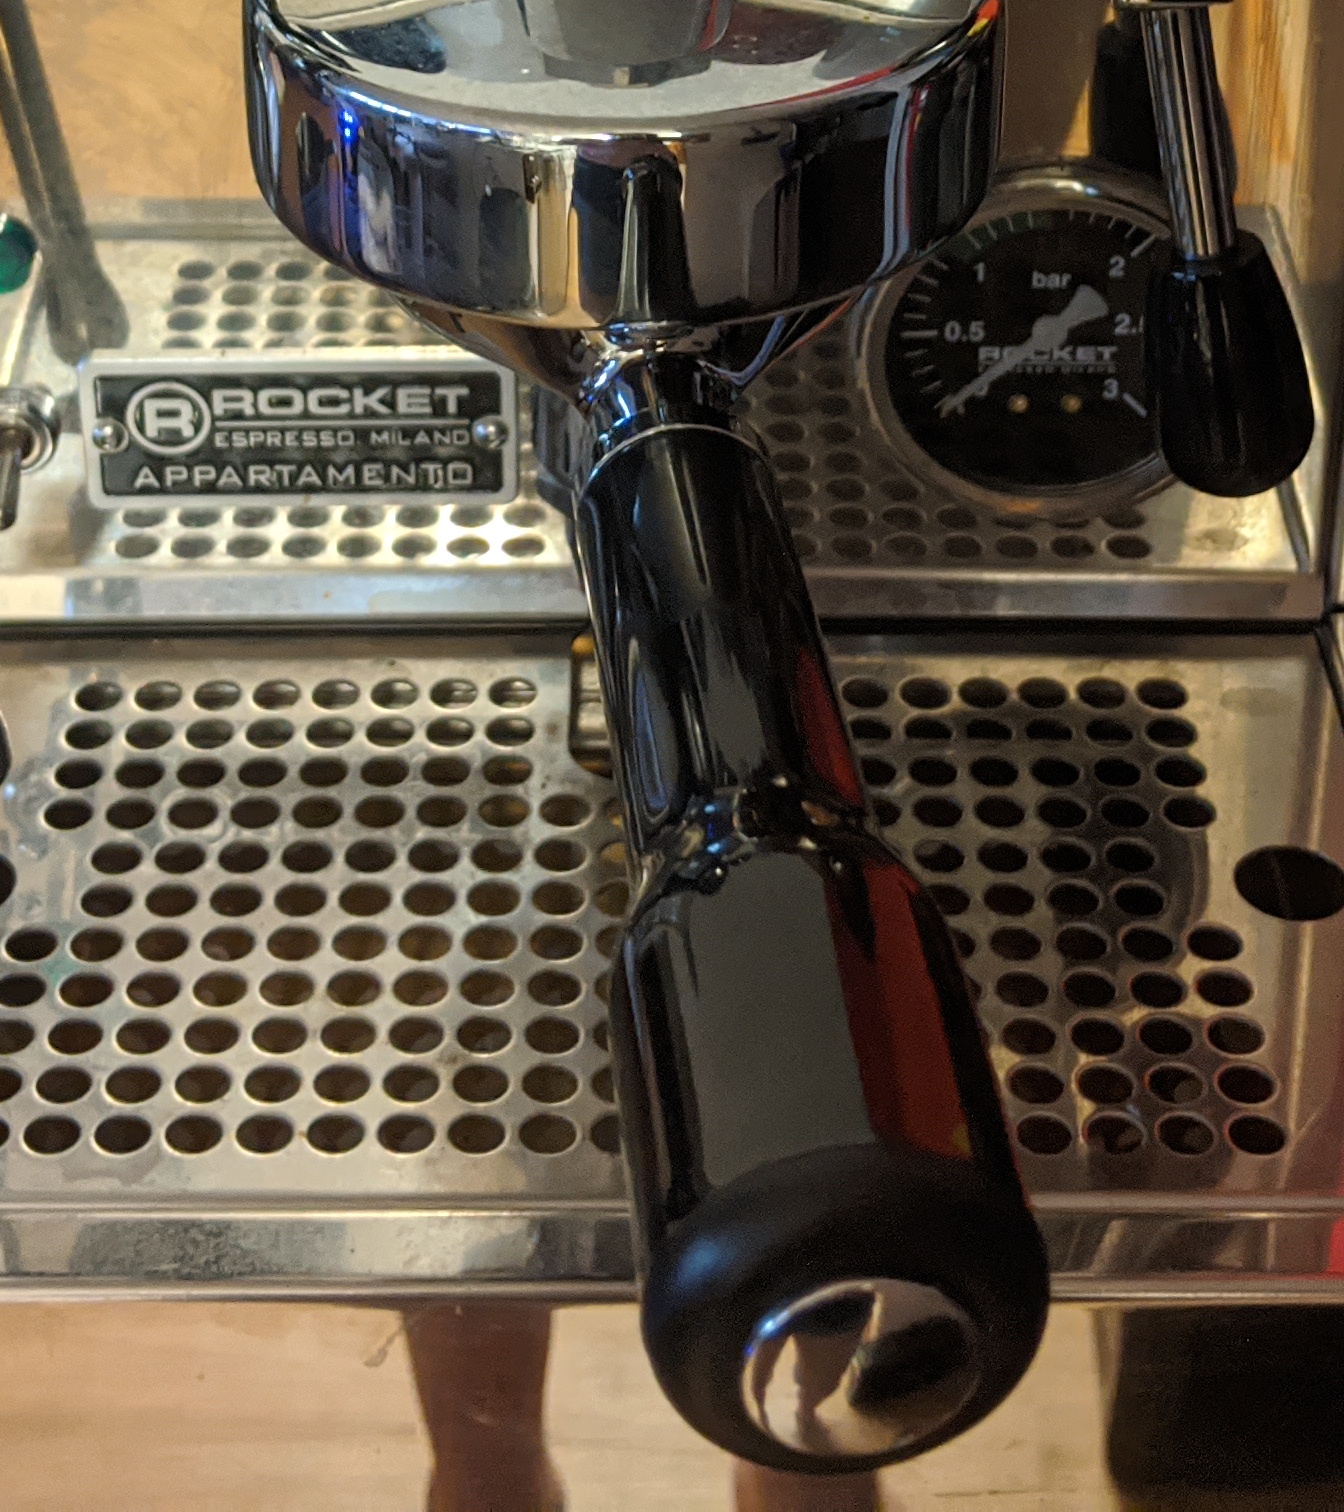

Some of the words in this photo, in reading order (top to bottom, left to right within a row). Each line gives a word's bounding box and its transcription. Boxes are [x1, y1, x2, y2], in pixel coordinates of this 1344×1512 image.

[974, 262, 985, 282] 1
[1032, 271, 1072, 289] bar
[1109, 255, 1125, 278] 2
[944, 320, 986, 342] 0.5
[1114, 313, 1143, 336] 2.
[211, 386, 470, 416] ROCKET
[1103, 378, 1118, 399] 3
[214, 430, 354, 449] ESPRESSO
[369, 429, 471, 447] MILANO
[133, 462, 474, 489] APPARTAMENTO
